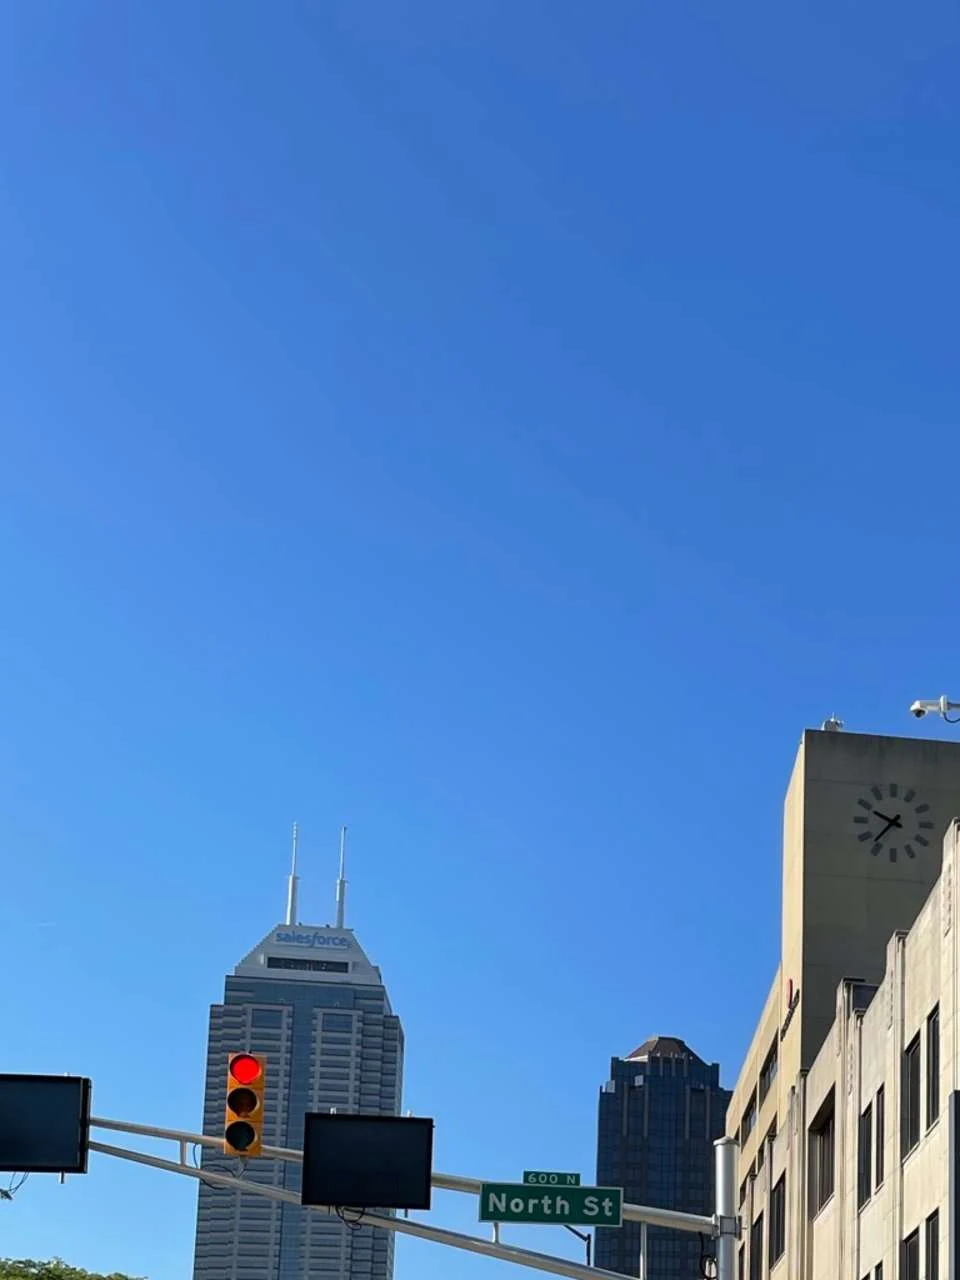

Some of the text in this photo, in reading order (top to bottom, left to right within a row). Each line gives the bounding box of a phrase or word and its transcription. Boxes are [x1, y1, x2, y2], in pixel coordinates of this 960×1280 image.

[276, 931, 347, 947] salesforce
[527, 1173, 576, 1185] 600 N
[488, 1193, 613, 1216] North St
